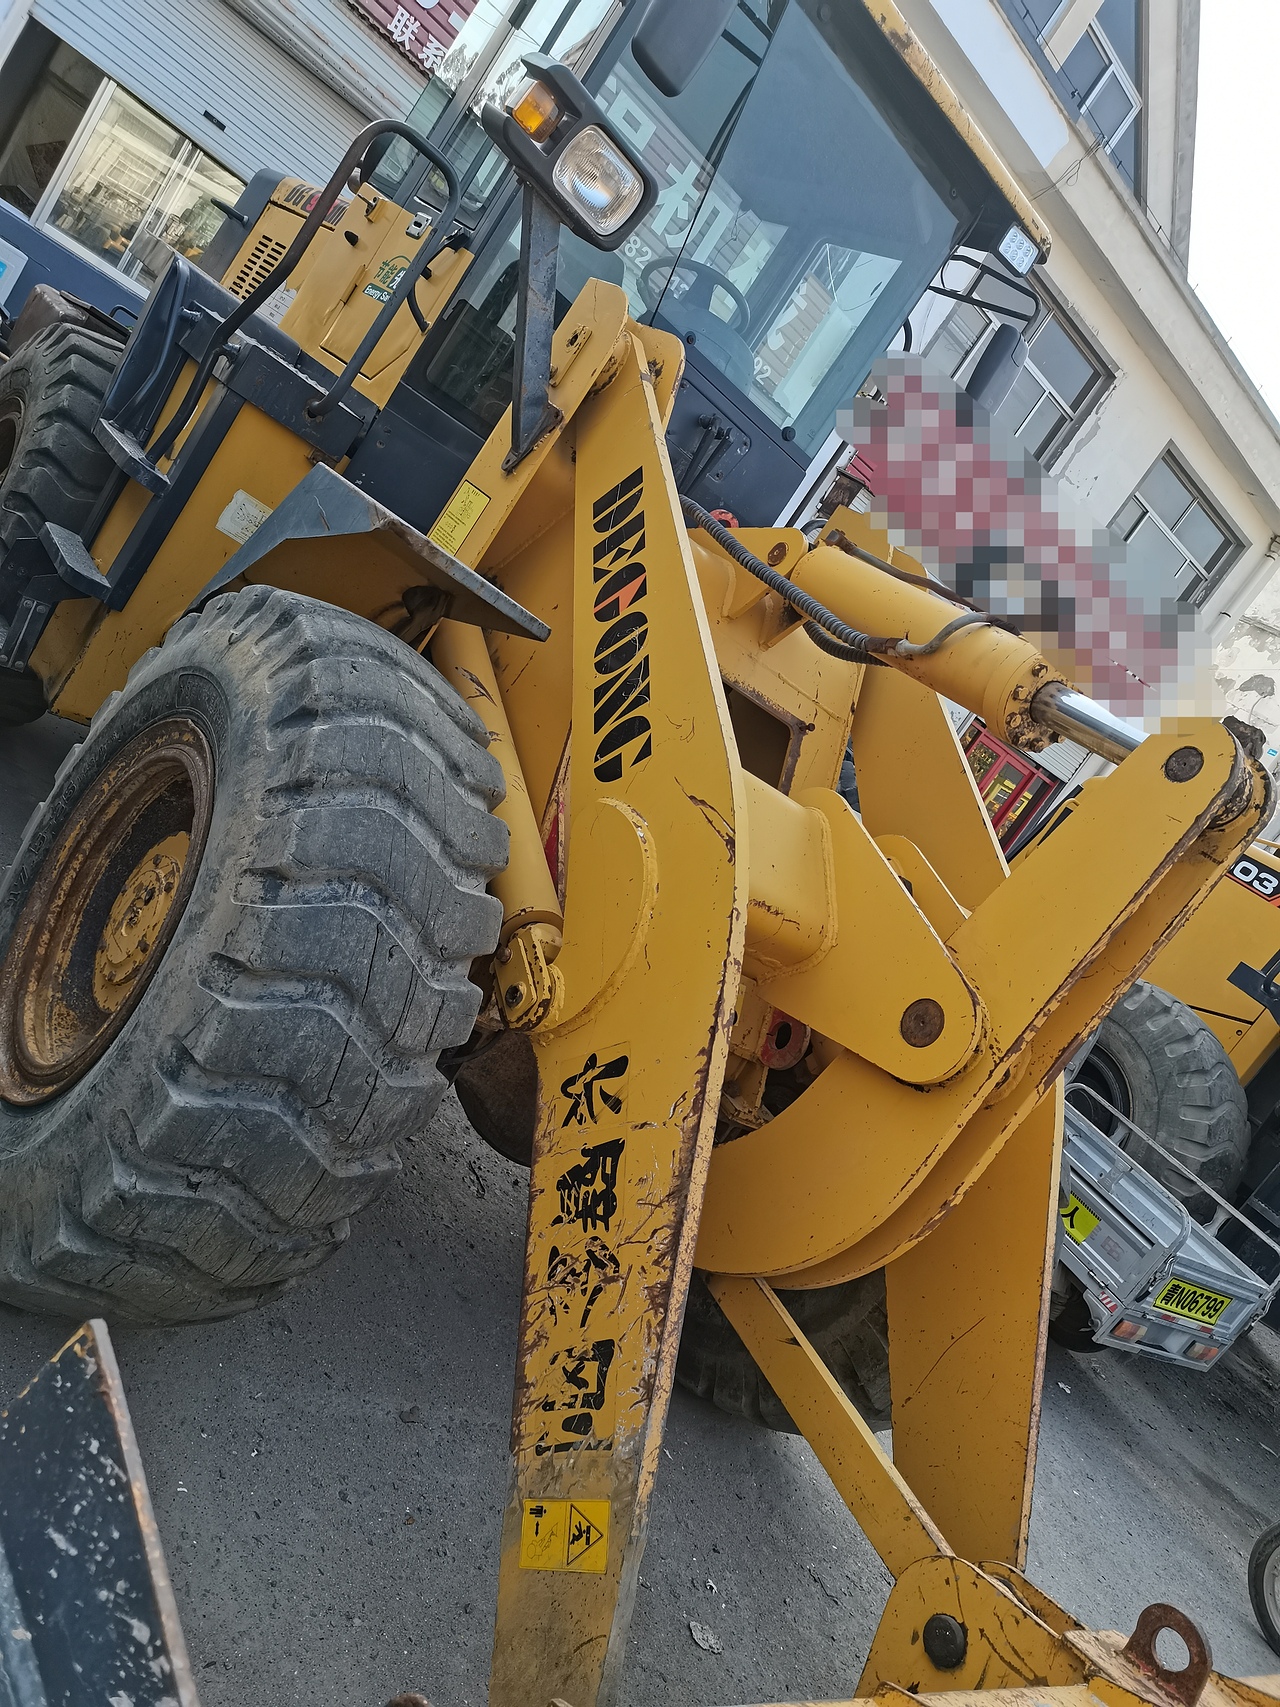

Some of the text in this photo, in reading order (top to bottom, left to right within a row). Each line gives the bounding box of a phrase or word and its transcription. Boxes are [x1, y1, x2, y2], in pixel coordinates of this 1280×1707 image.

[364, 285, 383, 300] Energy
[593, 465, 652, 783] DEGONG
[1231, 861, 1279, 895] 03
